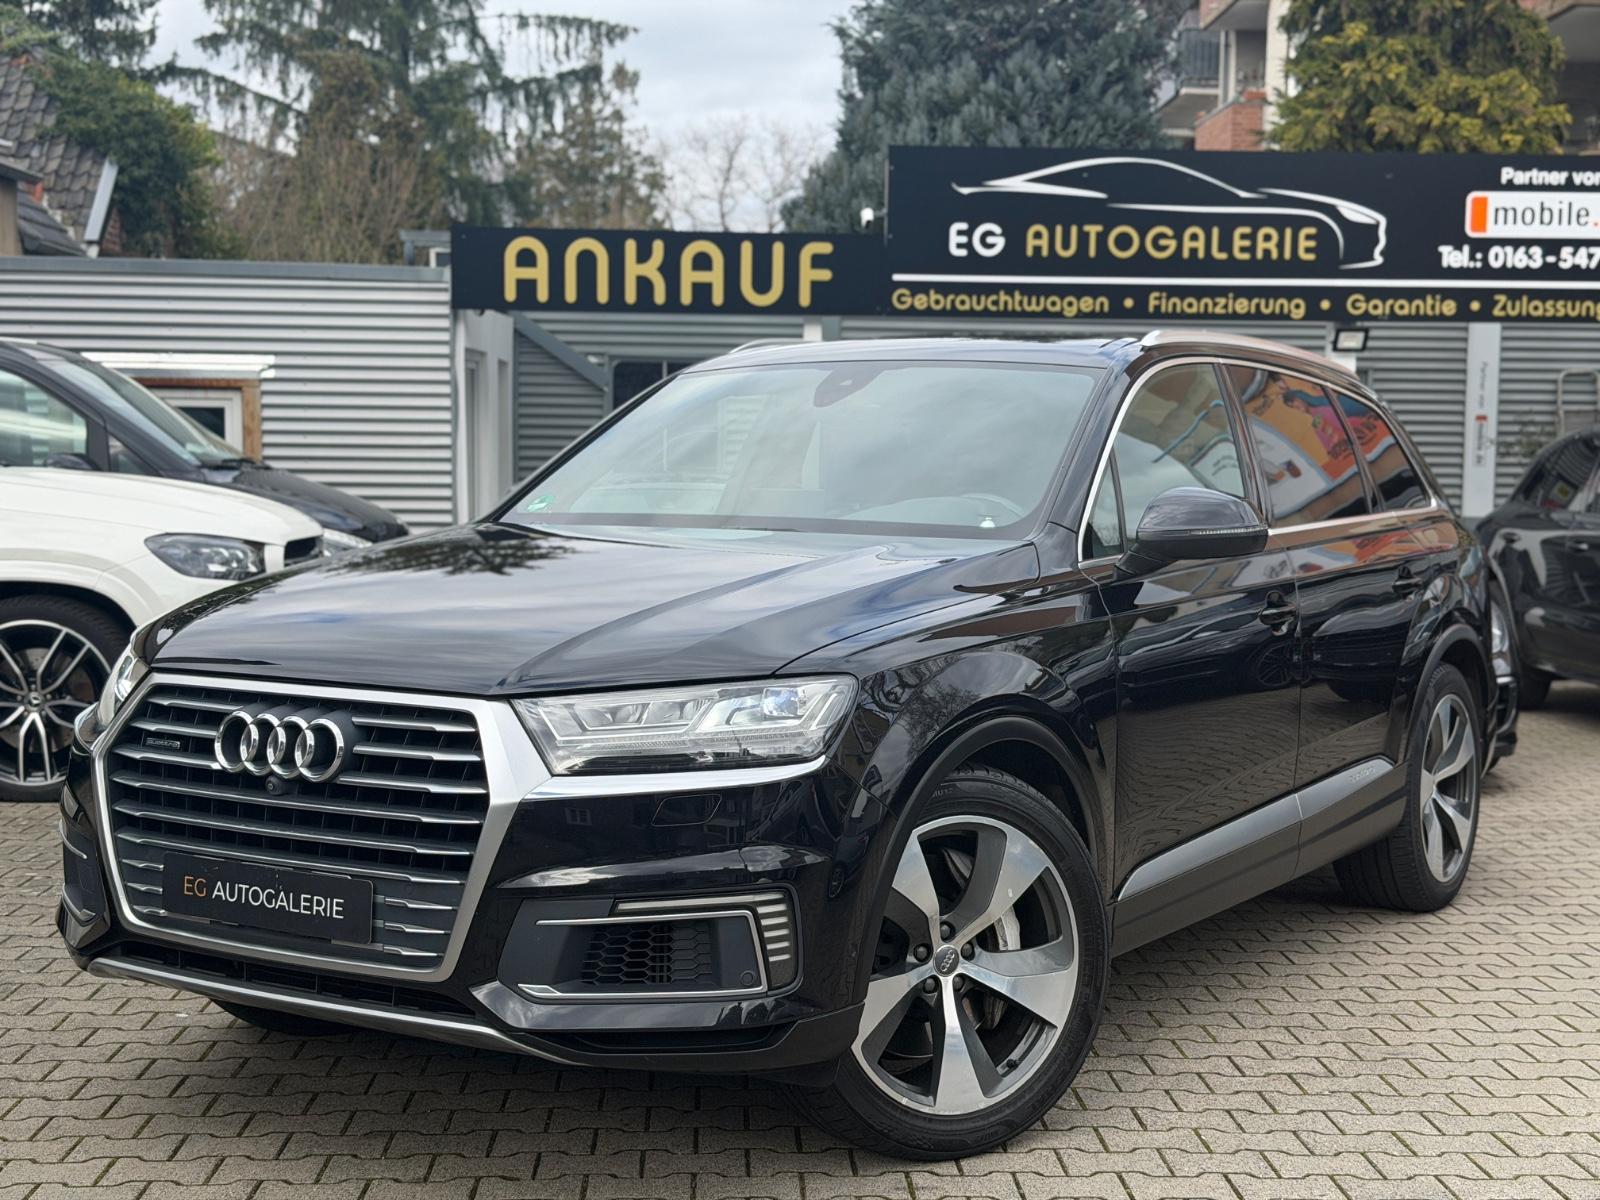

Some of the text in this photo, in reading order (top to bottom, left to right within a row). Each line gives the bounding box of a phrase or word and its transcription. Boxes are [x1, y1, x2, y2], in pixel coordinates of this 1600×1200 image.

[1500, 166, 1569, 186] Partner
[947, 221, 1318, 261] EG AUTOGALERIE
[1437, 243, 1483, 269] Tel.:
[503, 235, 834, 308] ANKAUF
[891, 287, 1110, 318] Gebrauchtwagen
[1148, 290, 1307, 320] Finanzierung
[1346, 293, 1458, 317] Garantie
[183, 875, 345, 919] EG AUTOGALERIE
